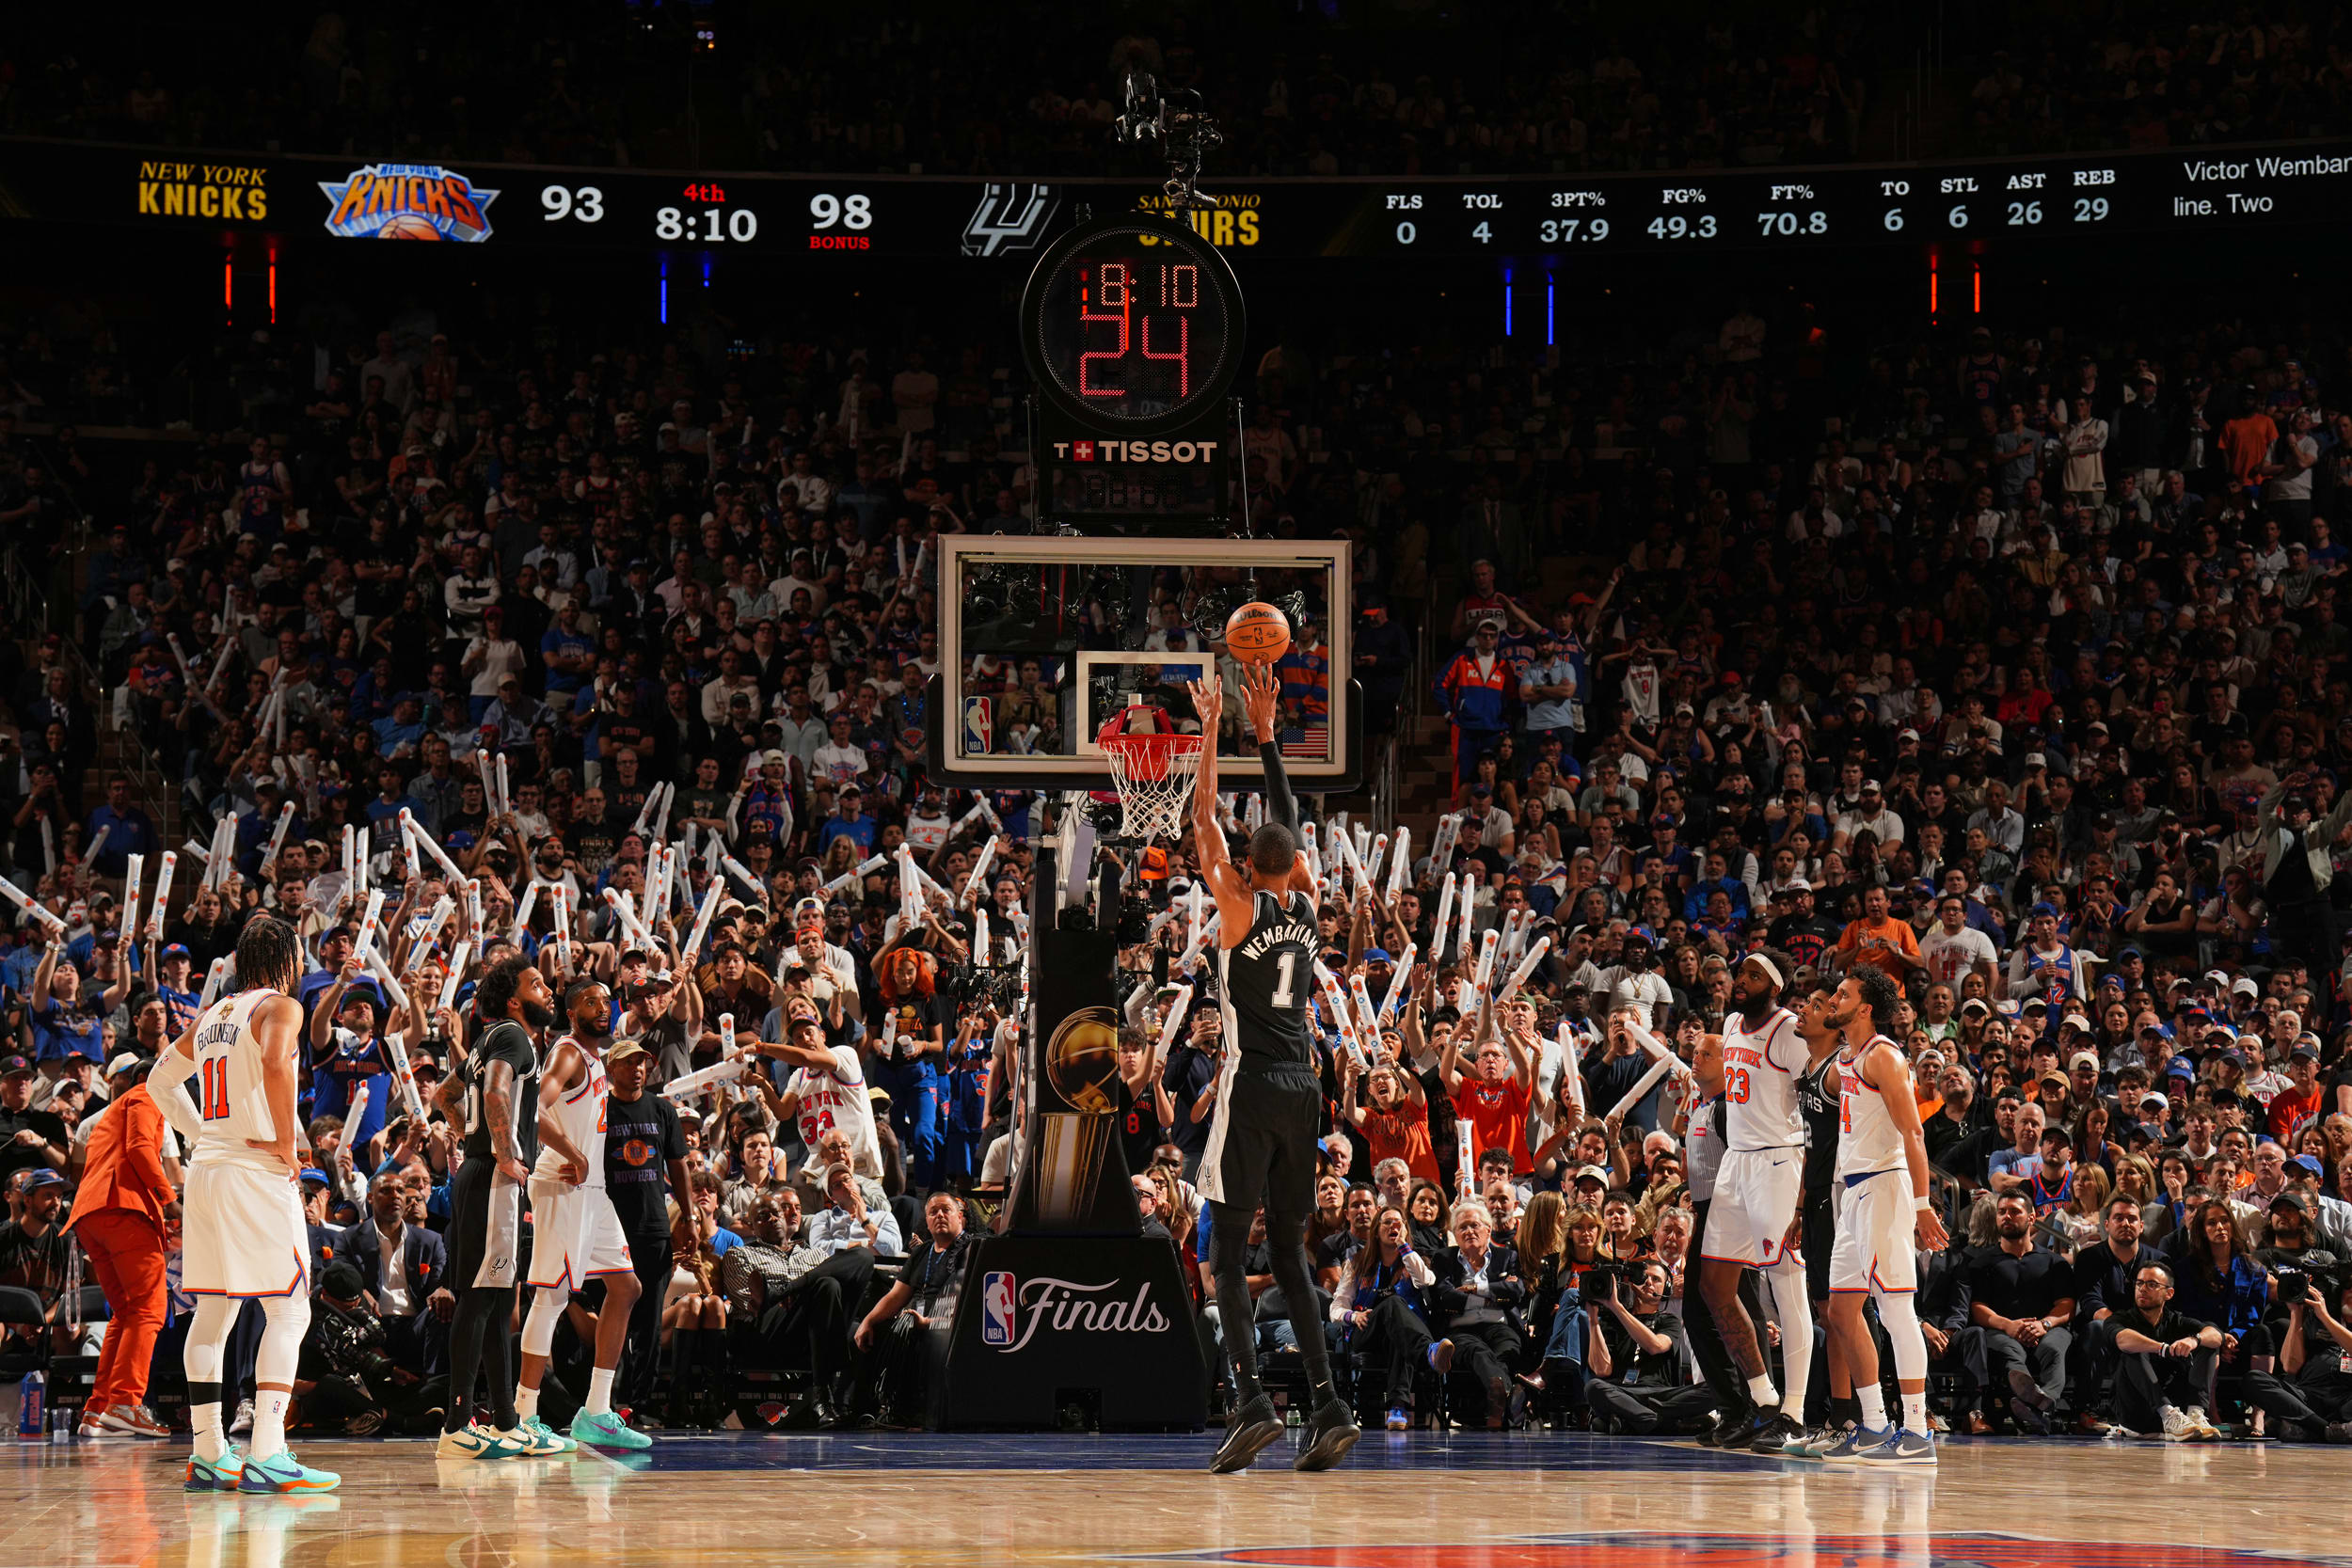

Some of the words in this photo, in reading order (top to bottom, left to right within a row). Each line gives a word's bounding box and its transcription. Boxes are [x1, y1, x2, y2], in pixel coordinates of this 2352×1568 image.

[140, 162, 194, 181] NEW
[203, 166, 267, 189] YORK
[2007, 173, 2046, 190] AST
[2074, 169, 2116, 185] REB
[2184, 161, 2249, 182] Victor
[683, 183, 725, 202] 4th
[1662, 188, 1707, 204] FG%
[1771, 184, 1814, 200] FT%
[1881, 181, 1910, 197] TO
[1941, 177, 1979, 194] STL
[139, 181, 266, 220] KNICKS
[332, 172, 485, 232] KNICKS
[541, 185, 604, 222] 93
[1386, 195, 1423, 210] FLS
[1463, 194, 1502, 209] TOL
[1550, 192, 1606, 207] 3PT%
[2074, 198, 2109, 222] 29
[2174, 197, 2218, 216] line.
[2226, 193, 2273, 214] Two
[811, 194, 872, 230] 98
[1757, 211, 1828, 236] 70.8
[1884, 208, 1903, 231] 6
[1948, 205, 1968, 228] 6
[2008, 200, 2042, 225] 26
[656, 207, 757, 242] 8:10
[1139, 210, 1260, 246] URS
[1396, 221, 1416, 245] 0
[1472, 221, 1492, 244] 4
[1540, 218, 1609, 243] 37.9
[1647, 214, 1717, 239] 49.3
[809, 235, 870, 250] BONUS
[1101, 263, 1198, 308] 8:10
[1079, 314, 1188, 398] 24
[1053, 443, 1069, 458] T
[1098, 440, 1217, 463] TISSOT
[968, 741, 982, 752] NBA
[1271, 951, 1295, 1009] 1
[198, 1023, 241, 1052] BRUNSON
[203, 1055, 230, 1121] 11
[1724, 1067, 1751, 1104] 23
[815, 1090, 844, 1108] YRK
[637, 1122, 660, 1136] YORK
[1126, 1113, 1140, 1134] 8
[613, 1168, 658, 1183] NOWHERE
[998, 1276, 1169, 1354] Finals
[987, 1327, 1004, 1339] NBA
